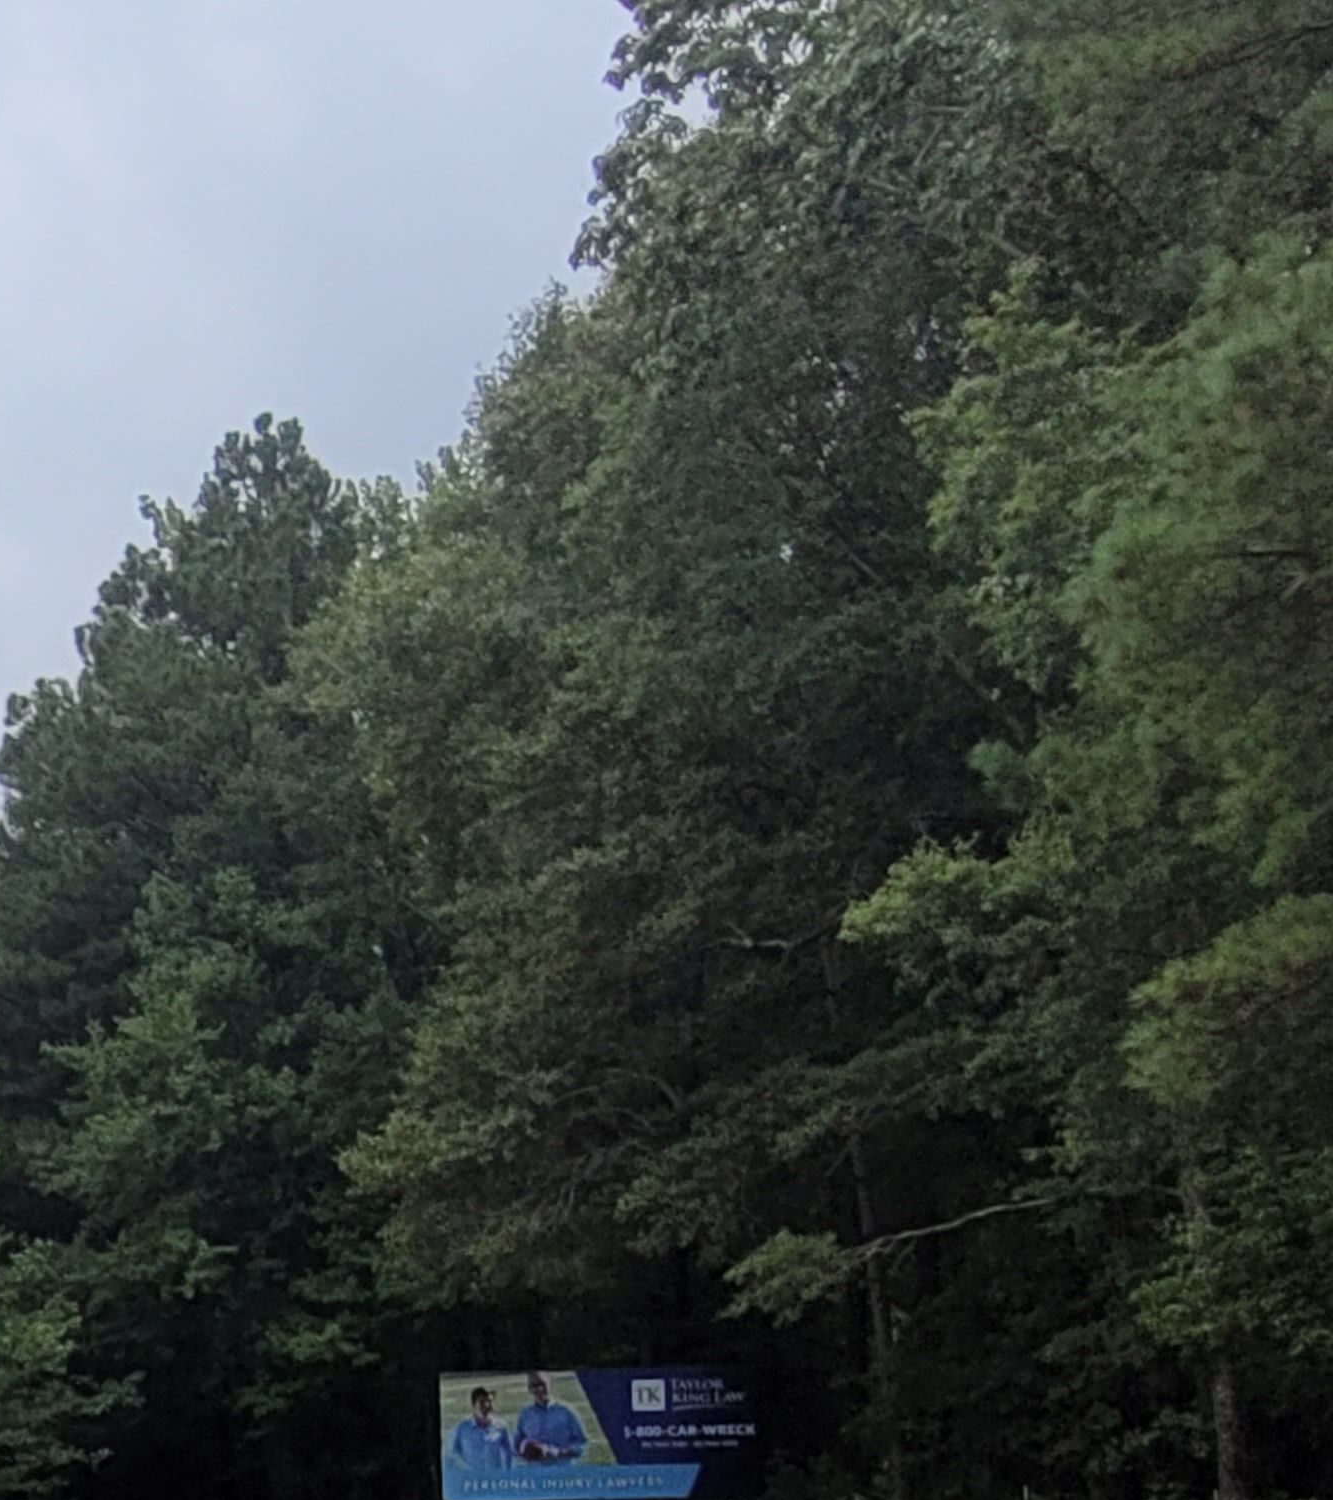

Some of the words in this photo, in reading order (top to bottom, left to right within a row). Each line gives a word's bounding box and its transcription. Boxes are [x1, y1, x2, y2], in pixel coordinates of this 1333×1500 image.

[671, 1378, 724, 1390] TAYLOR
[623, 1424, 756, 1438] 1-800-CAR-WRECK
[464, 1478, 536, 1491] PERSONAL
[542, 1478, 591, 1490] INJURY
[597, 1476, 663, 1489] LAWYERS
